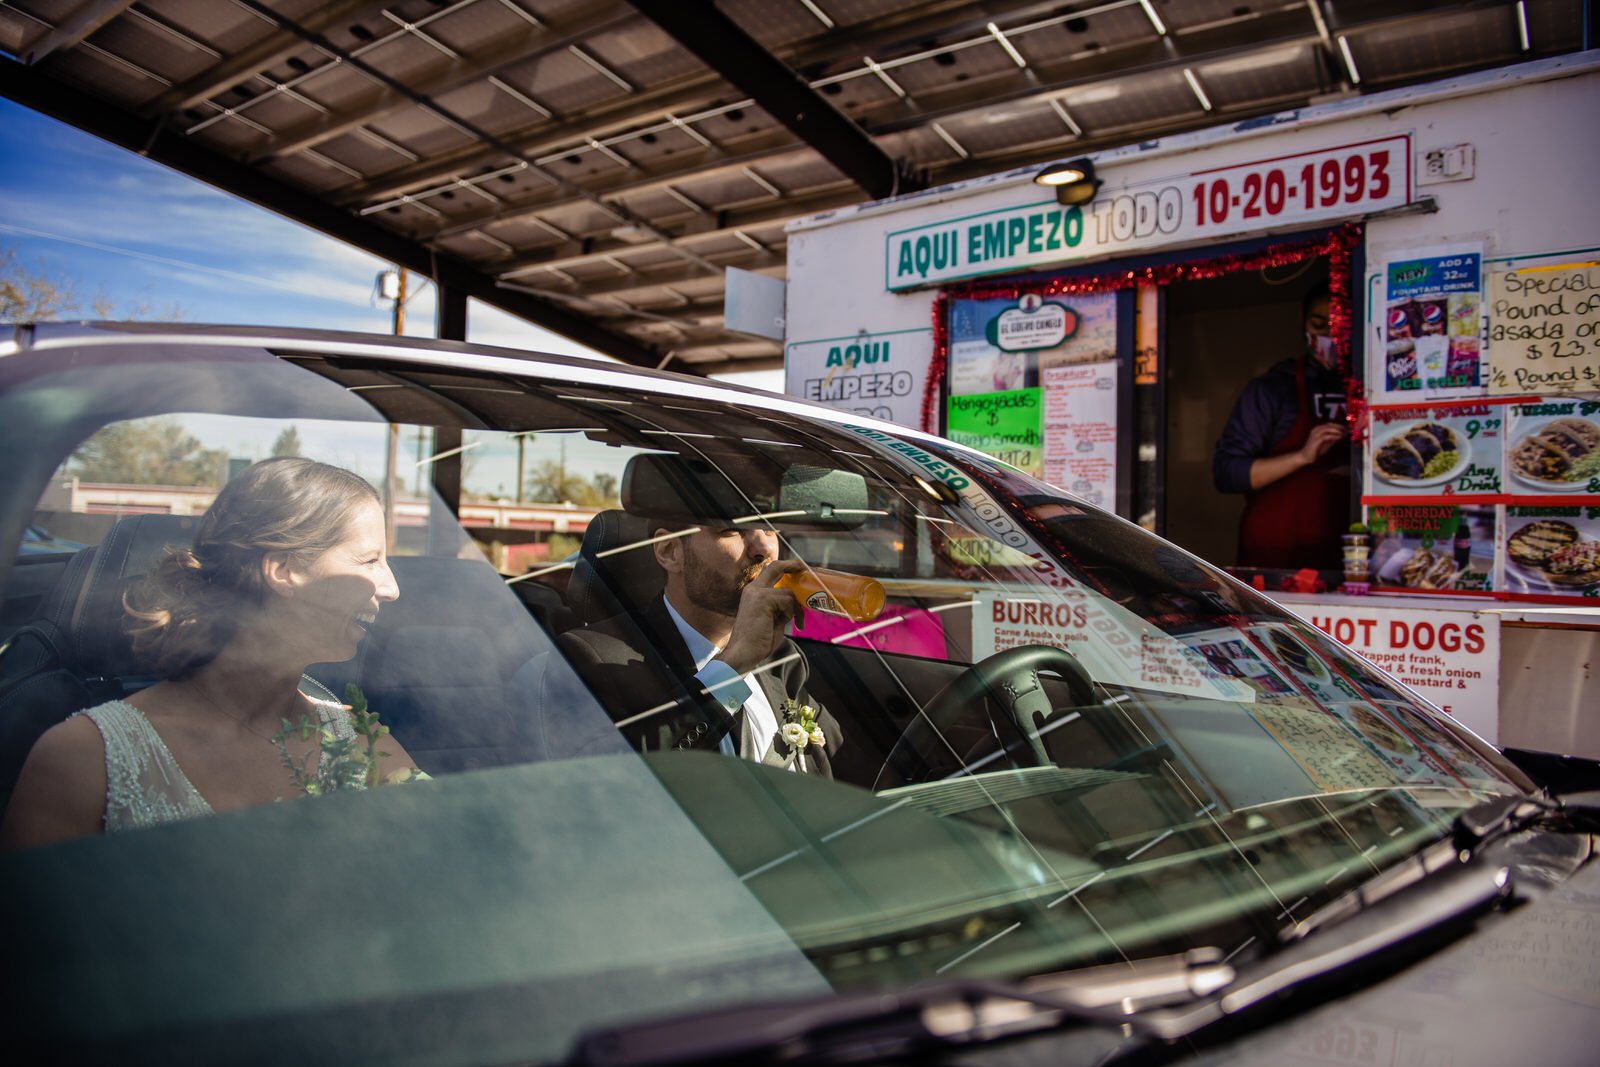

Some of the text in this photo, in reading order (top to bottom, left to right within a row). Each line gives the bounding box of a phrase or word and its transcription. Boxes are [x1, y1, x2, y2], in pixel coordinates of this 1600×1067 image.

[897, 150, 1390, 279] AQUI EMPEZO TODO 10-20-1993
[1438, 257, 1473, 268] ADD A
[1392, 281, 1474, 297] FOUNTAIN DRINK
[1504, 271, 1600, 297] Special
[1495, 295, 1571, 319] Pound
[1490, 321, 1564, 342] asada
[825, 341, 890, 369] AQUI
[1396, 374, 1468, 390] ICE COLD
[1514, 366, 1579, 384] Pound
[804, 371, 913, 401] EMPEZO
[1464, 463, 1495, 480] Any
[1457, 476, 1502, 494] Drink
[1375, 506, 1455, 519] WEDNESDAY
[992, 600, 1088, 629] BURROS
[994, 627, 1021, 638] Carne
[1023, 629, 1053, 640] Asada
[1063, 632, 1089, 642] pollo
[994, 635, 1015, 646] Beef
[1312, 617, 1485, 654] HOT DOGS
[1409, 653, 1446, 667] frank,
[1396, 664, 1406, 674] &
[1410, 665, 1441, 676] fresh
[1445, 669, 1481, 679] onion
[1401, 676, 1467, 690] mustard &
